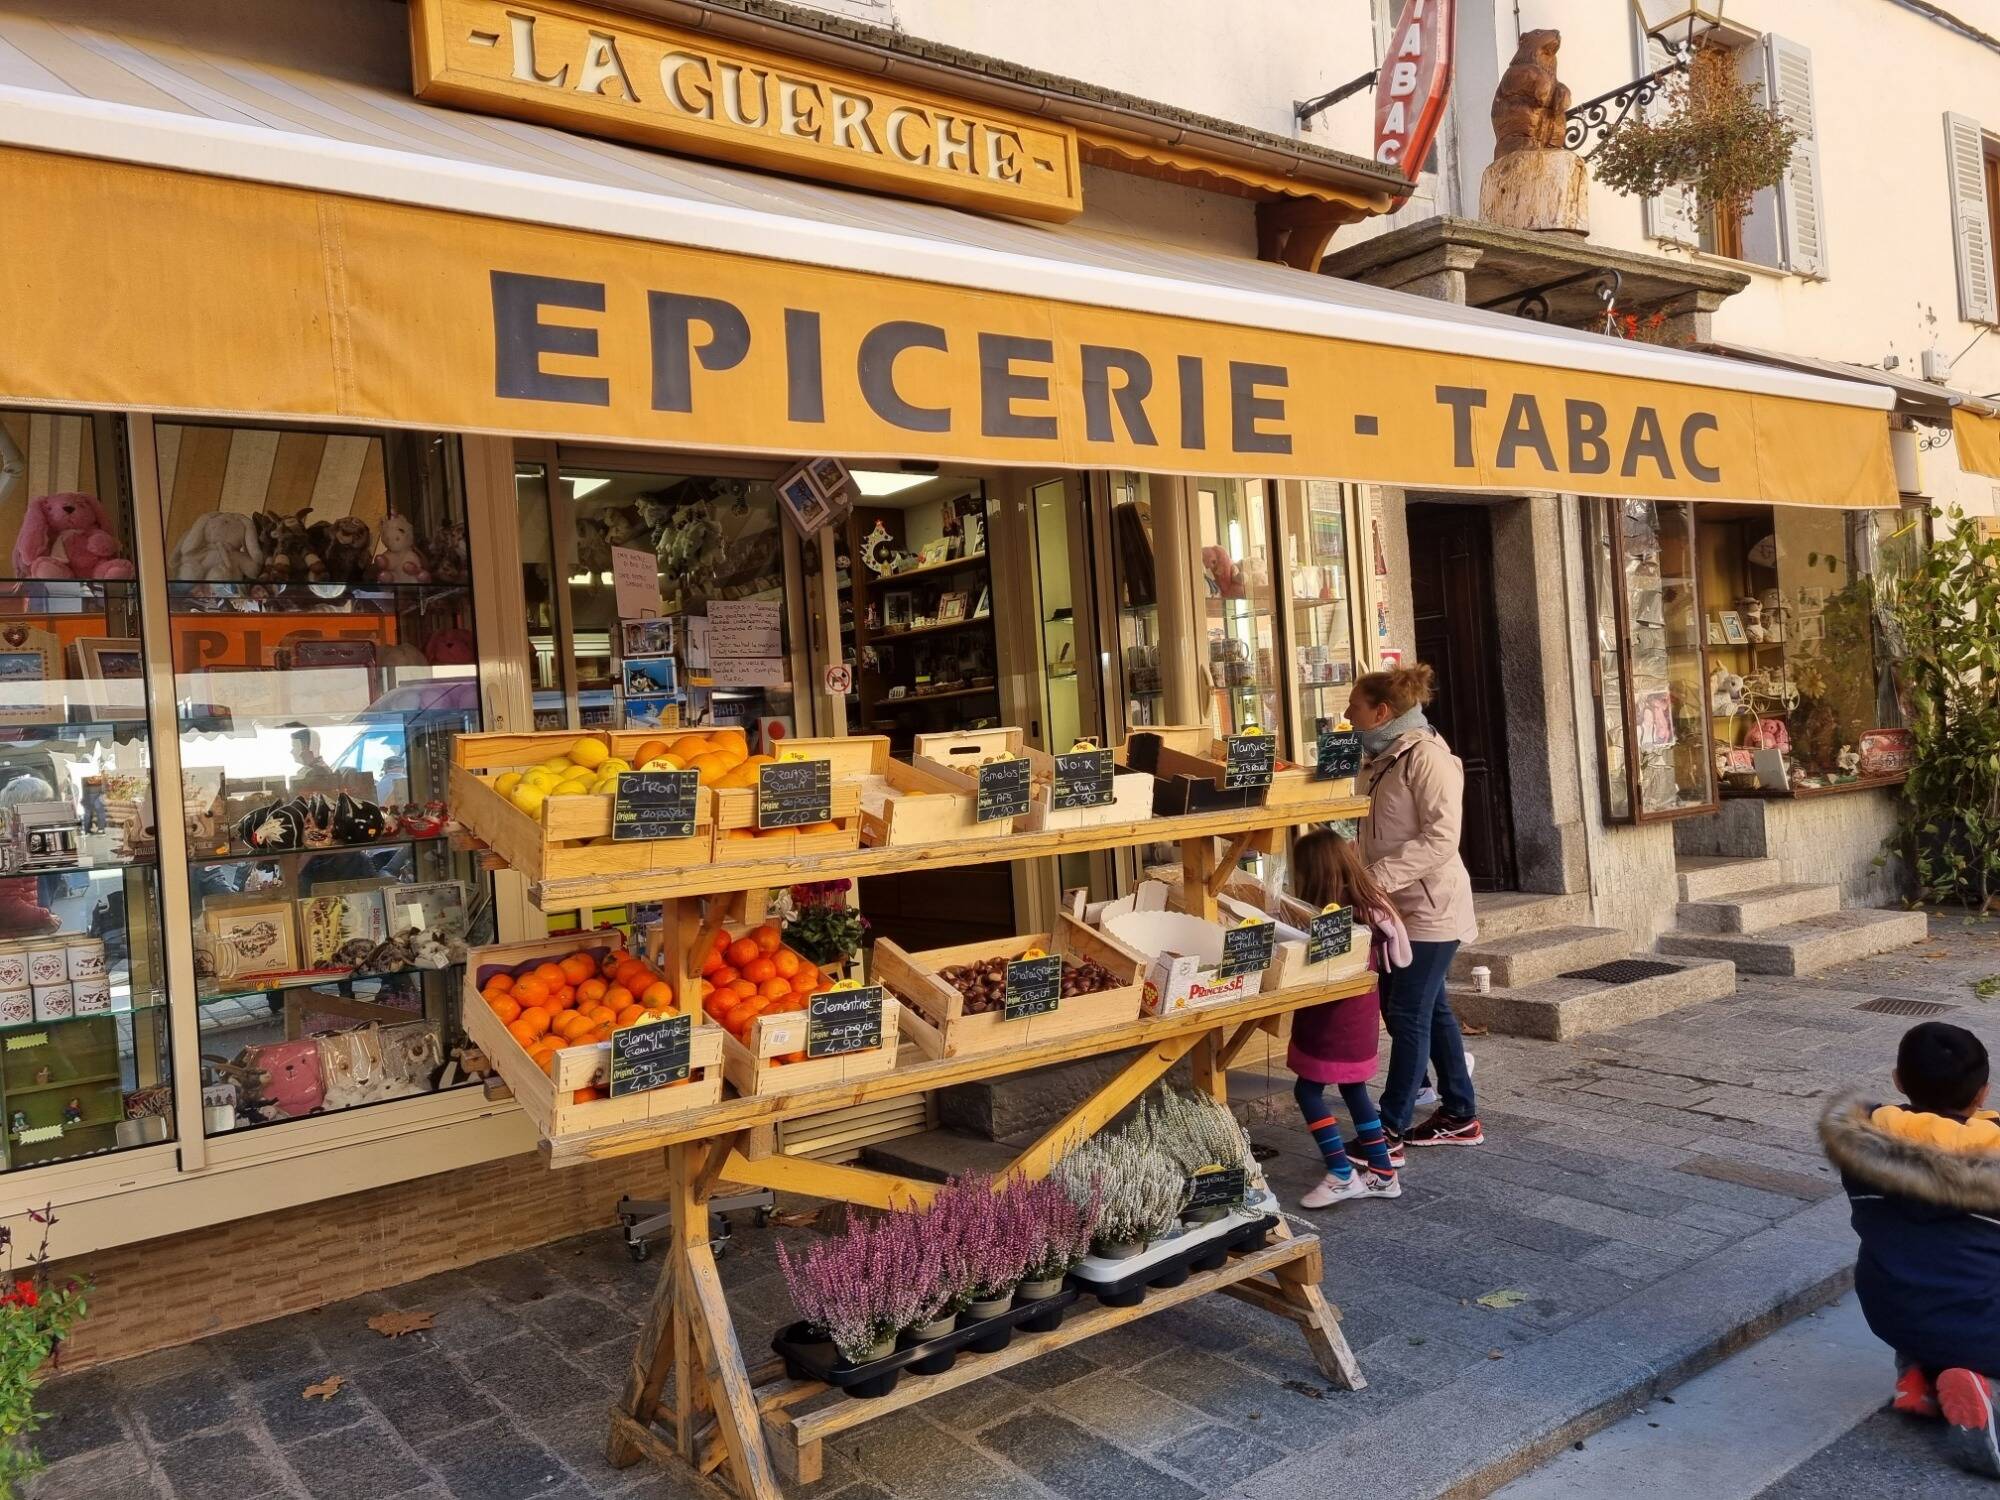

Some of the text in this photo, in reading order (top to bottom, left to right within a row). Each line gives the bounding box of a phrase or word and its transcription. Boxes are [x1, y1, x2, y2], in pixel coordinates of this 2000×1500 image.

[505, 9, 641, 103] LA
[658, 48, 1026, 186] GUERCHE
[489, 269, 1293, 455] EPICERIE
[1435, 384, 1721, 484] TABAC
[616, 811, 638, 822] Origine
